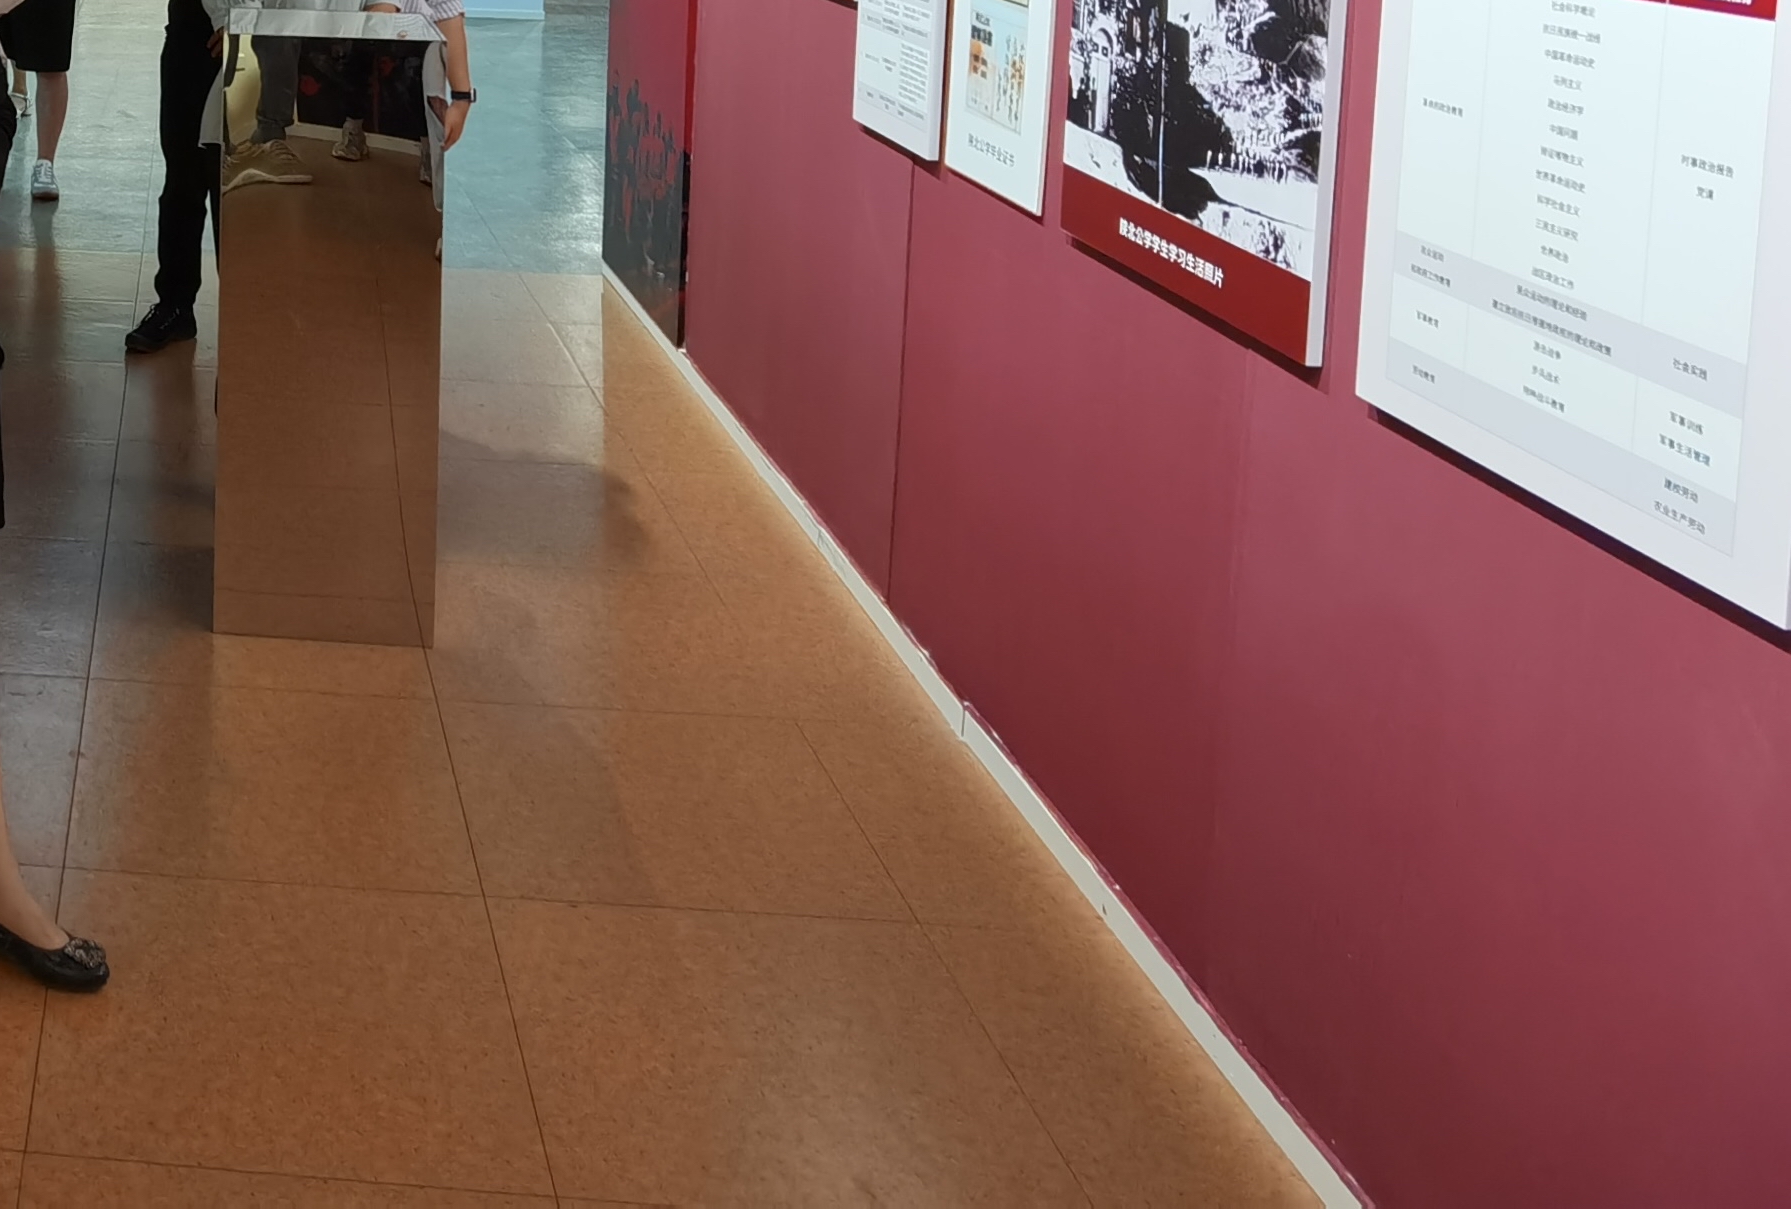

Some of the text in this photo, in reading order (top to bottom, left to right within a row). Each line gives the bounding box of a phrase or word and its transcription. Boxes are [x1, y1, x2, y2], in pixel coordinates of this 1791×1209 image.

[1680, 153, 1734, 179] 时事政治报告
[1119, 217, 1224, 289] 陕北公学学生学习生活照片
[1672, 357, 1708, 381] 社会实践
[1659, 433, 1710, 467] 军事生活管理
[1653, 499, 1706, 536] 农业生产劳动
